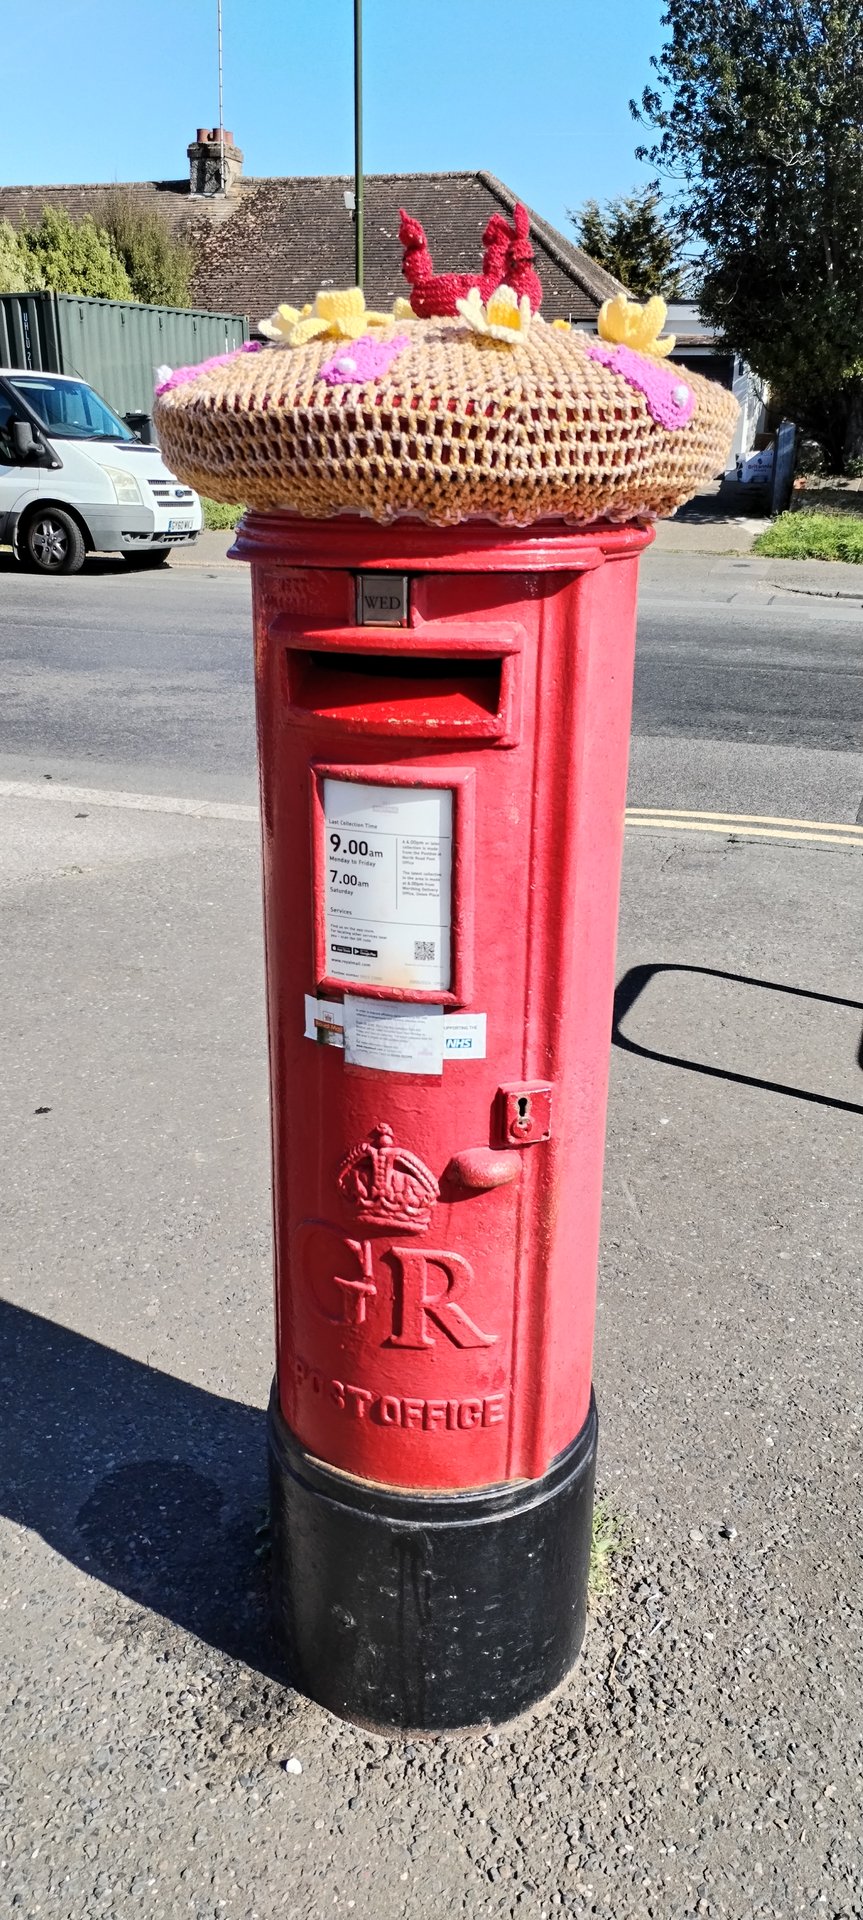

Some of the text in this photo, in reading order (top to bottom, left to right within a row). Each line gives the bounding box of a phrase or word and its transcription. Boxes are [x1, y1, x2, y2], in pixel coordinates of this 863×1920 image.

[364, 596, 401, 610] WED
[340, 820, 364, 828] Collection
[329, 833, 384, 858] 9.00am
[329, 856, 350, 864] Monday
[358, 859, 376, 867] Friday
[329, 869, 369, 888] 7.00am
[330, 887, 353, 896] Saturday
[330, 907, 353, 916] Services
[446, 1038, 471, 1049] NHS
[297, 1359, 505, 1431] POST OFFICE
